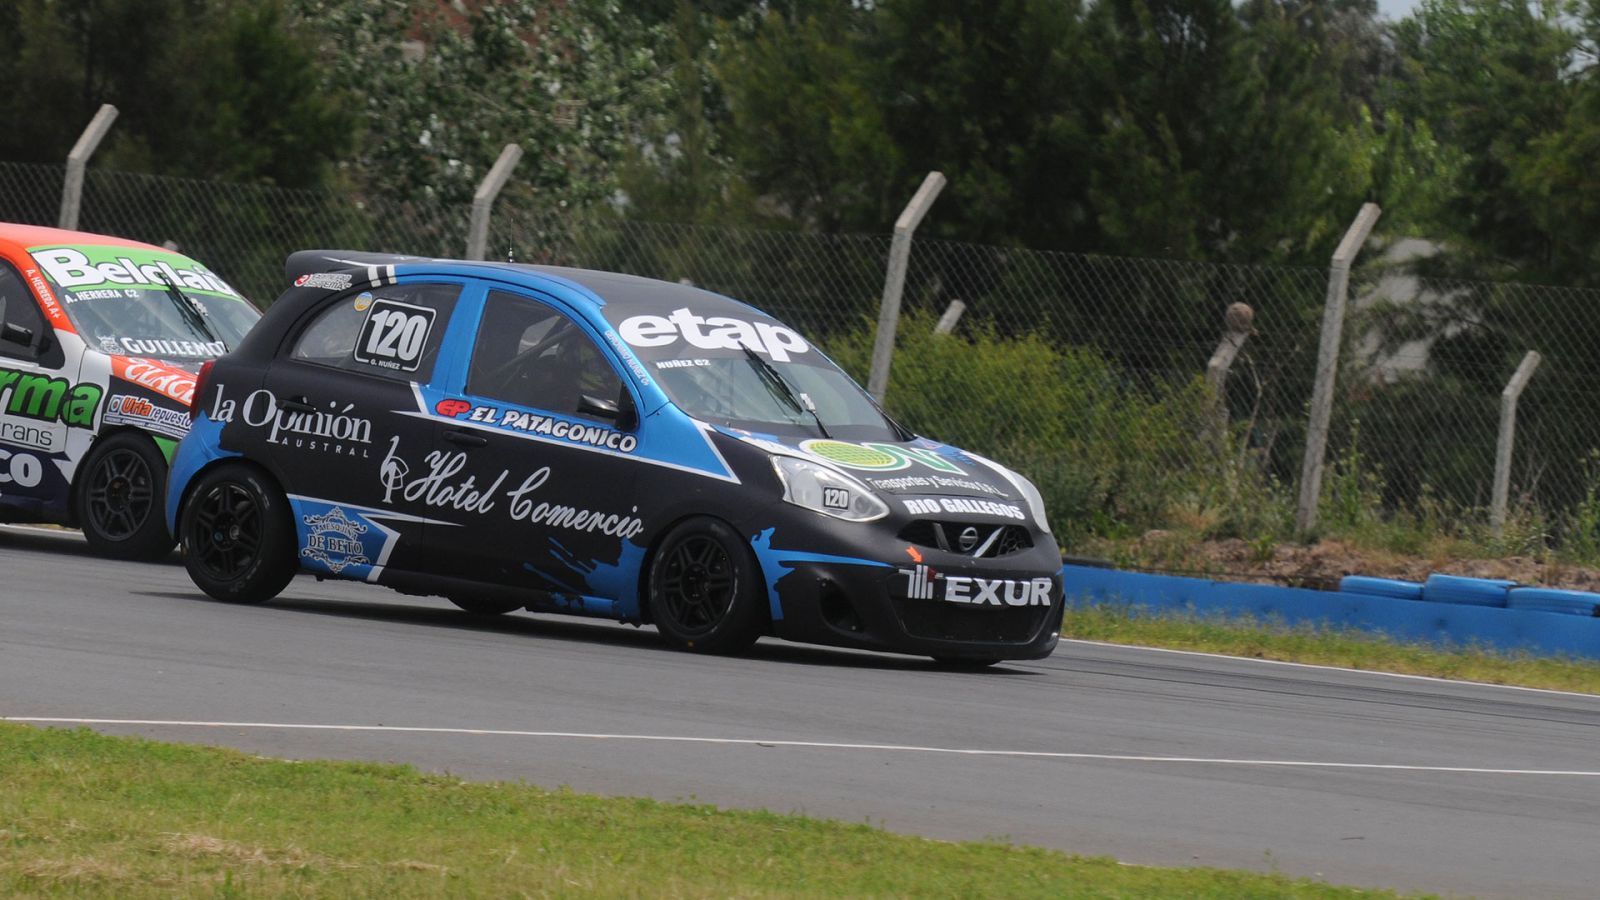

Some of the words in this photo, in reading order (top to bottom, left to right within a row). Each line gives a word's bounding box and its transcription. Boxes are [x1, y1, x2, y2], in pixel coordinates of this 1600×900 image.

[75, 289, 123, 301] HERRERA
[124, 288, 140, 298] C2
[365, 309, 428, 362] 120
[618, 307, 810, 363] etap
[378, 360, 401, 370] NUÑEZ
[656, 359, 695, 369] NUÑEZ
[208, 384, 237, 424] la
[242, 388, 373, 445] Opinión
[0, 421, 53, 446] rans
[469, 406, 497, 425] EL
[500, 410, 638, 453] PATAGONICO
[281, 436, 370, 459] AUSTRAL
[404, 450, 510, 514] Hotel
[507, 466, 645, 540] Comercio
[865, 477, 930, 491] Transportes
[824, 488, 849, 508] 120
[902, 498, 942, 515] RIO
[939, 498, 1026, 521] GALLEGOS
[307, 533, 325, 551] DE
[327, 536, 364, 556] BETO
[943, 576, 1053, 607] EXUR
